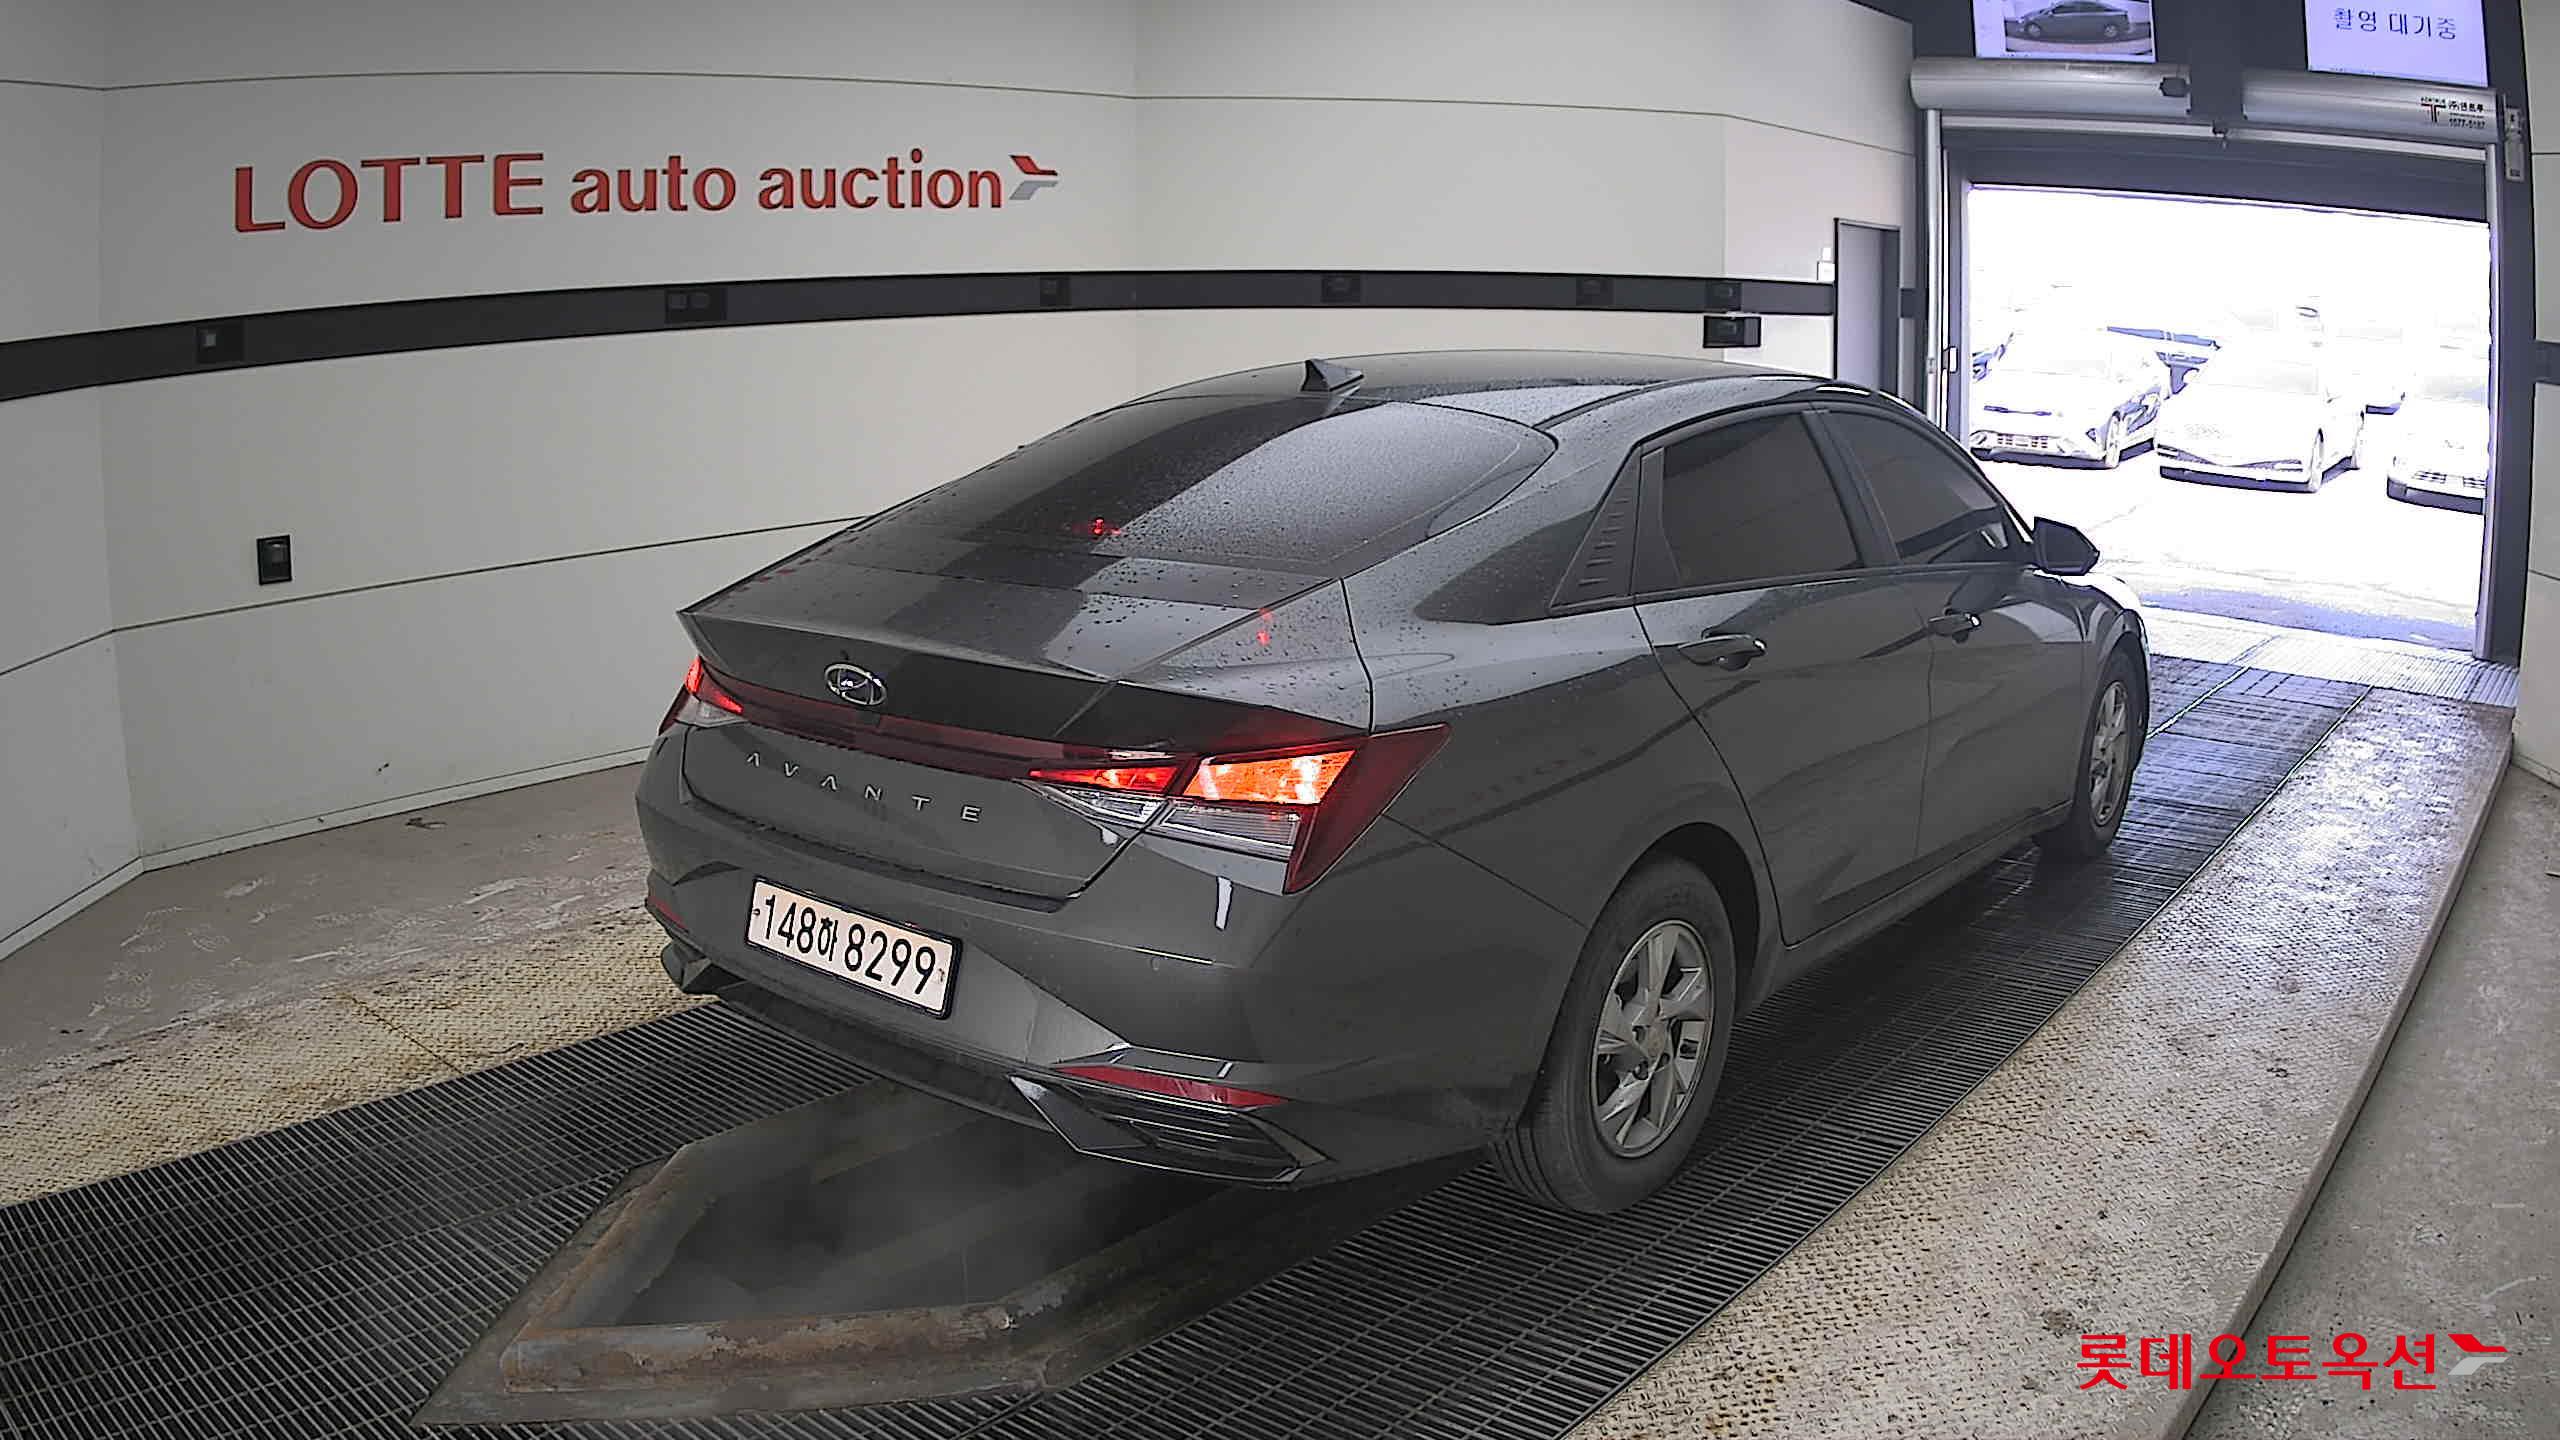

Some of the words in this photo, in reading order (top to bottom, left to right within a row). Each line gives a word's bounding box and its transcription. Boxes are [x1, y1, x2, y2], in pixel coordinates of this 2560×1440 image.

[2335, 8, 2377, 32] 촬영
[2388, 13, 2457, 40] 대기중
[234, 152, 544, 234] LOTTE
[569, 155, 736, 213] auto
[758, 148, 1004, 210] auction
[747, 752, 981, 822] AVANTE
[765, 894, 839, 962] 148하
[844, 923, 936, 995] 8299
